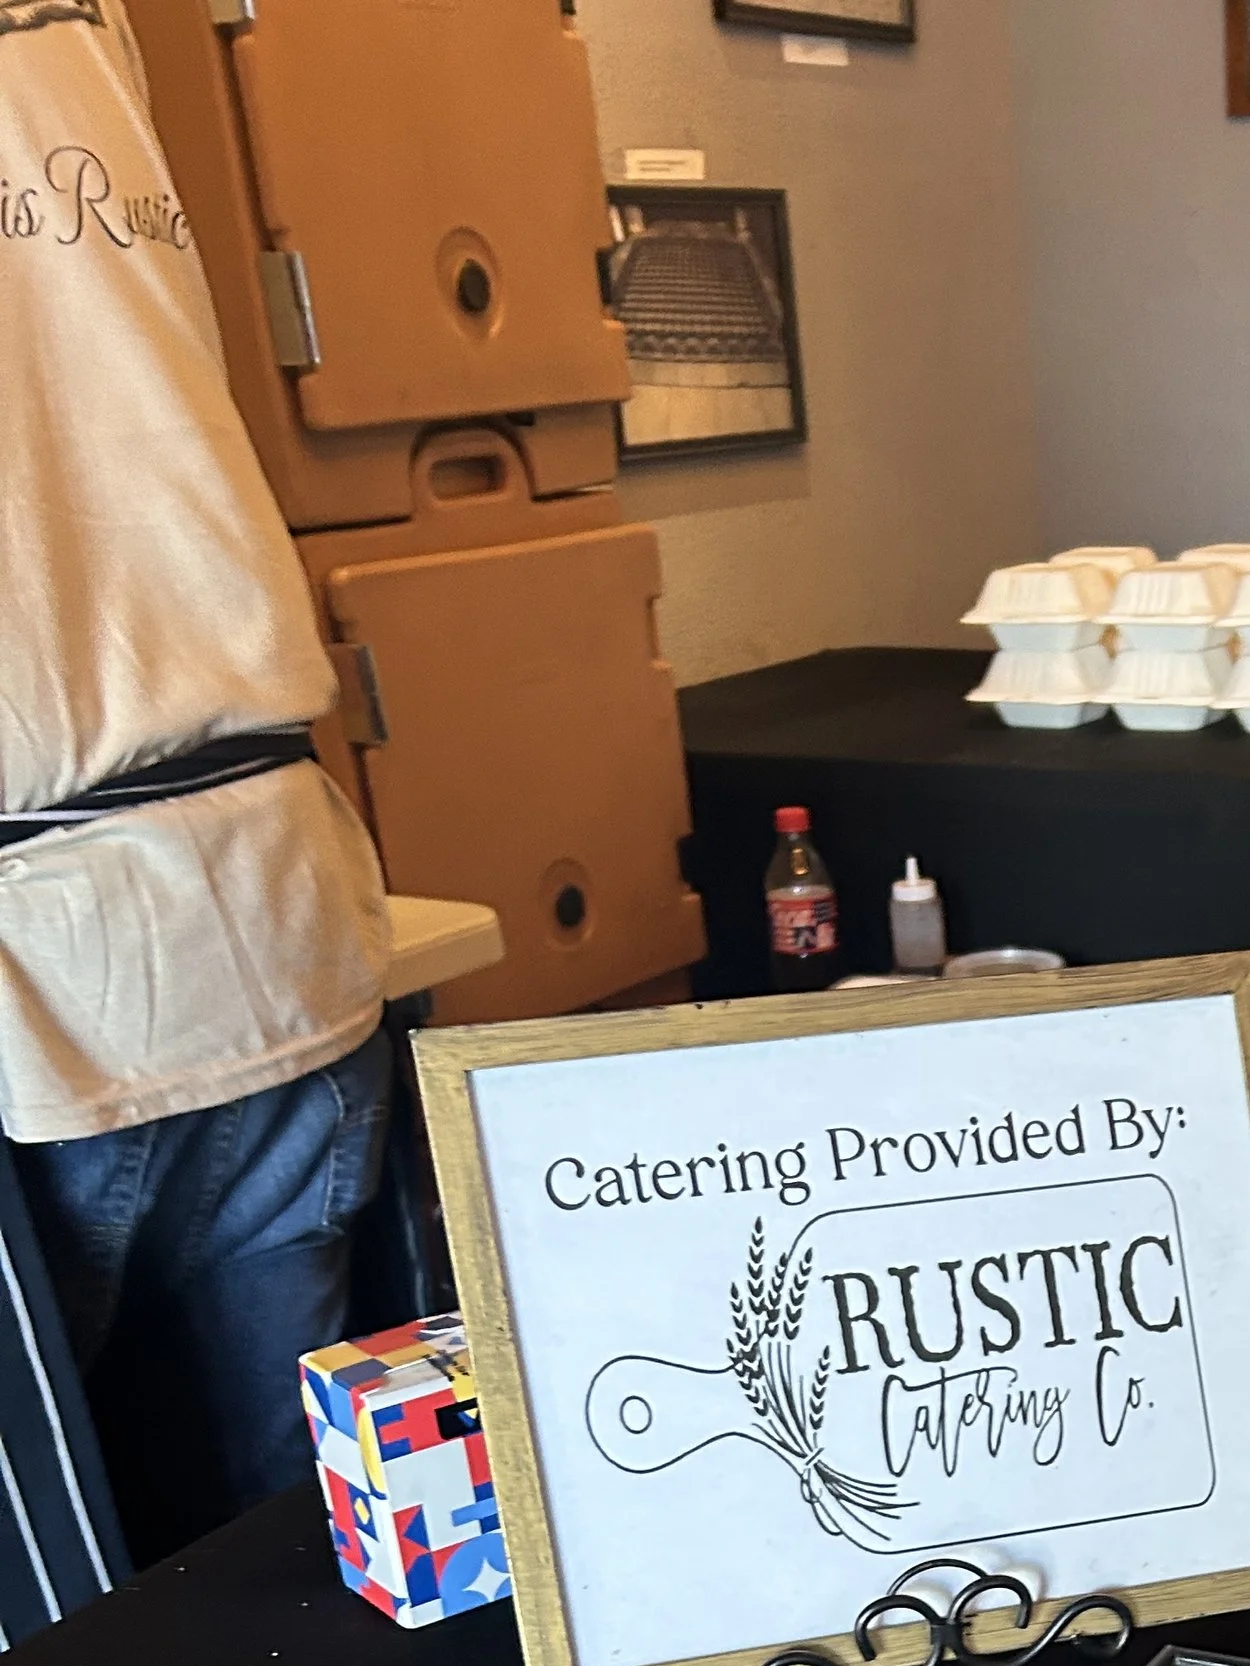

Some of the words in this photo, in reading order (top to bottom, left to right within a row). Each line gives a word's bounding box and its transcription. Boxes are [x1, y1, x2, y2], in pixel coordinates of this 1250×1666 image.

[544, 1141, 812, 1211] Catering
[824, 1103, 1086, 1181] Provided
[1102, 1097, 1187, 1160] By:
[821, 1234, 1184, 1375] RUSTIC
[881, 1366, 1071, 1478] Catering
[1096, 1345, 1155, 1447] Co.
